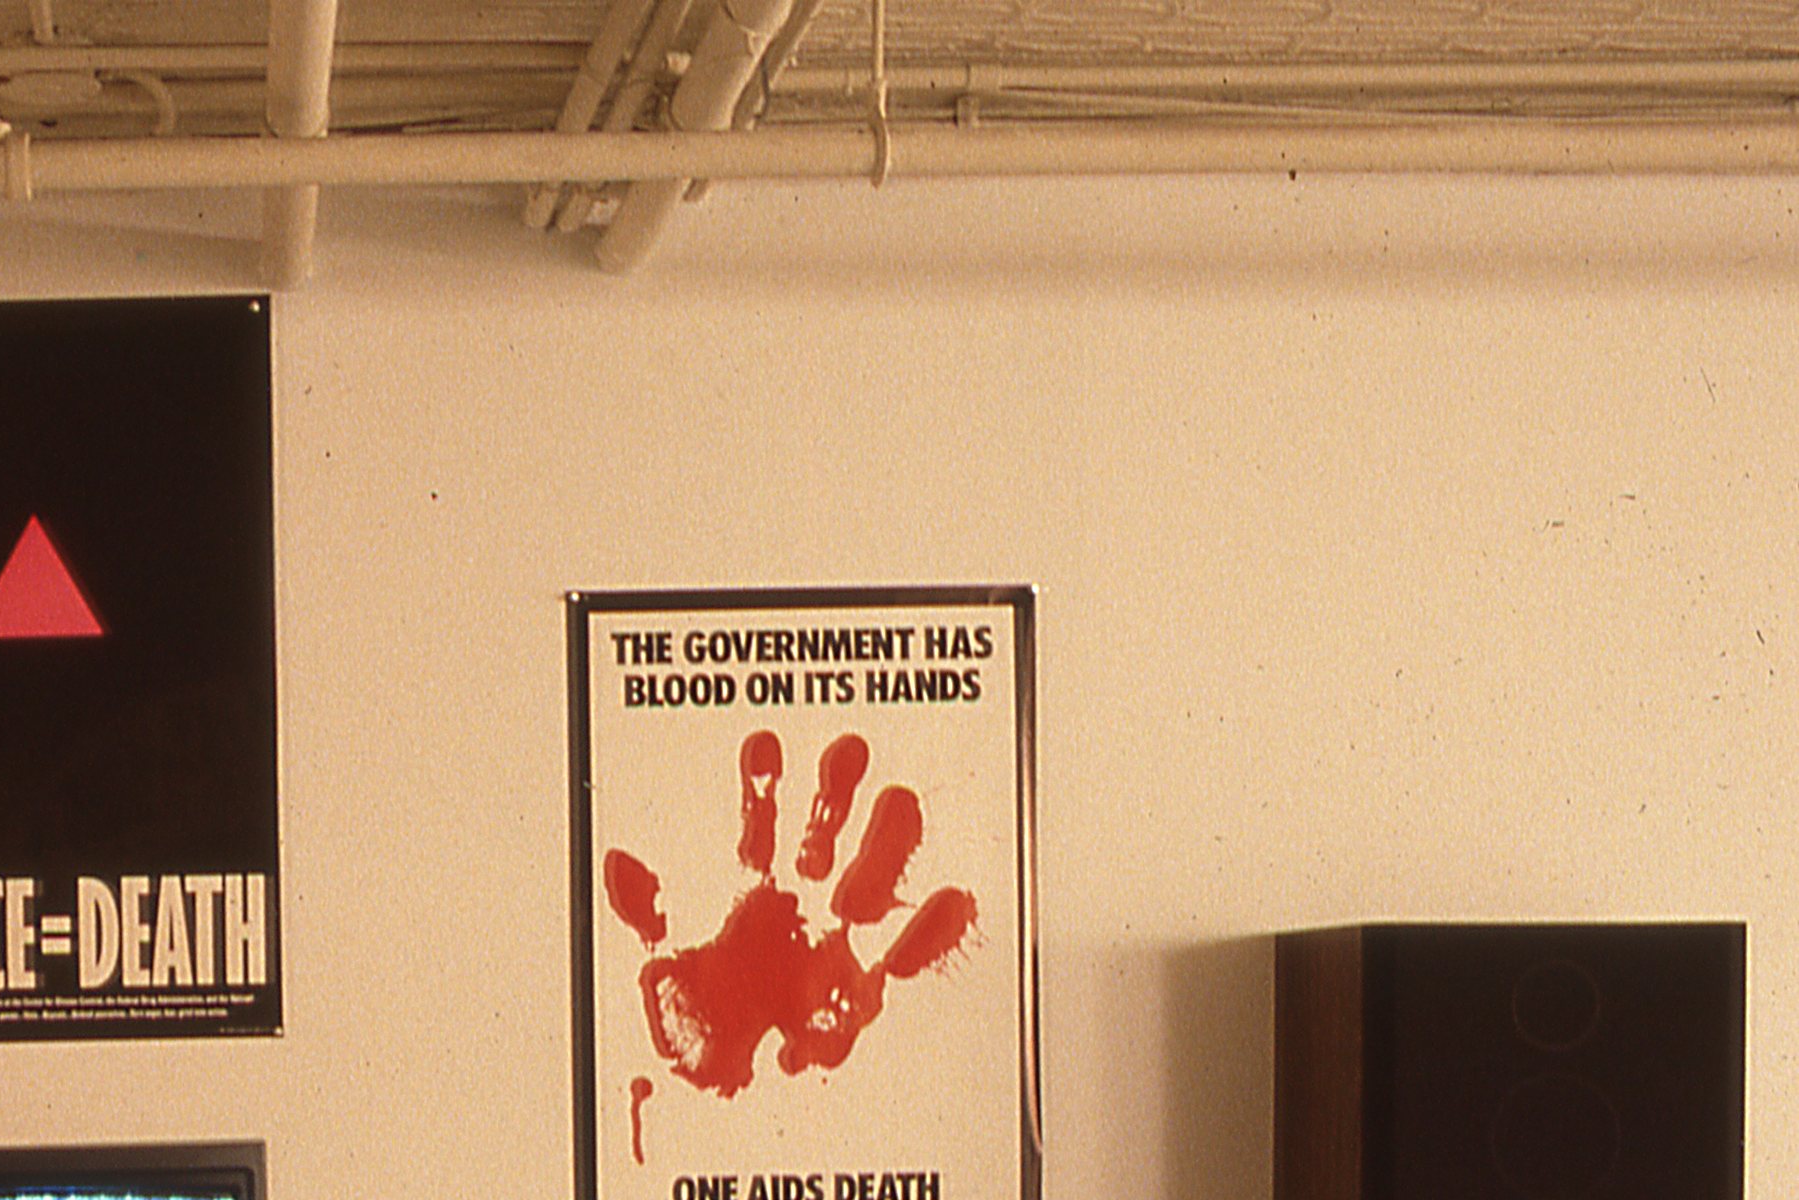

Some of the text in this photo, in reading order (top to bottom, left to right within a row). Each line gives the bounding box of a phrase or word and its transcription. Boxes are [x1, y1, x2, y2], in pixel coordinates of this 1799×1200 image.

[610, 625, 994, 664] THE GOVERNMENT HAS
[624, 668, 982, 708] BLOOD ON ITS HANDS
